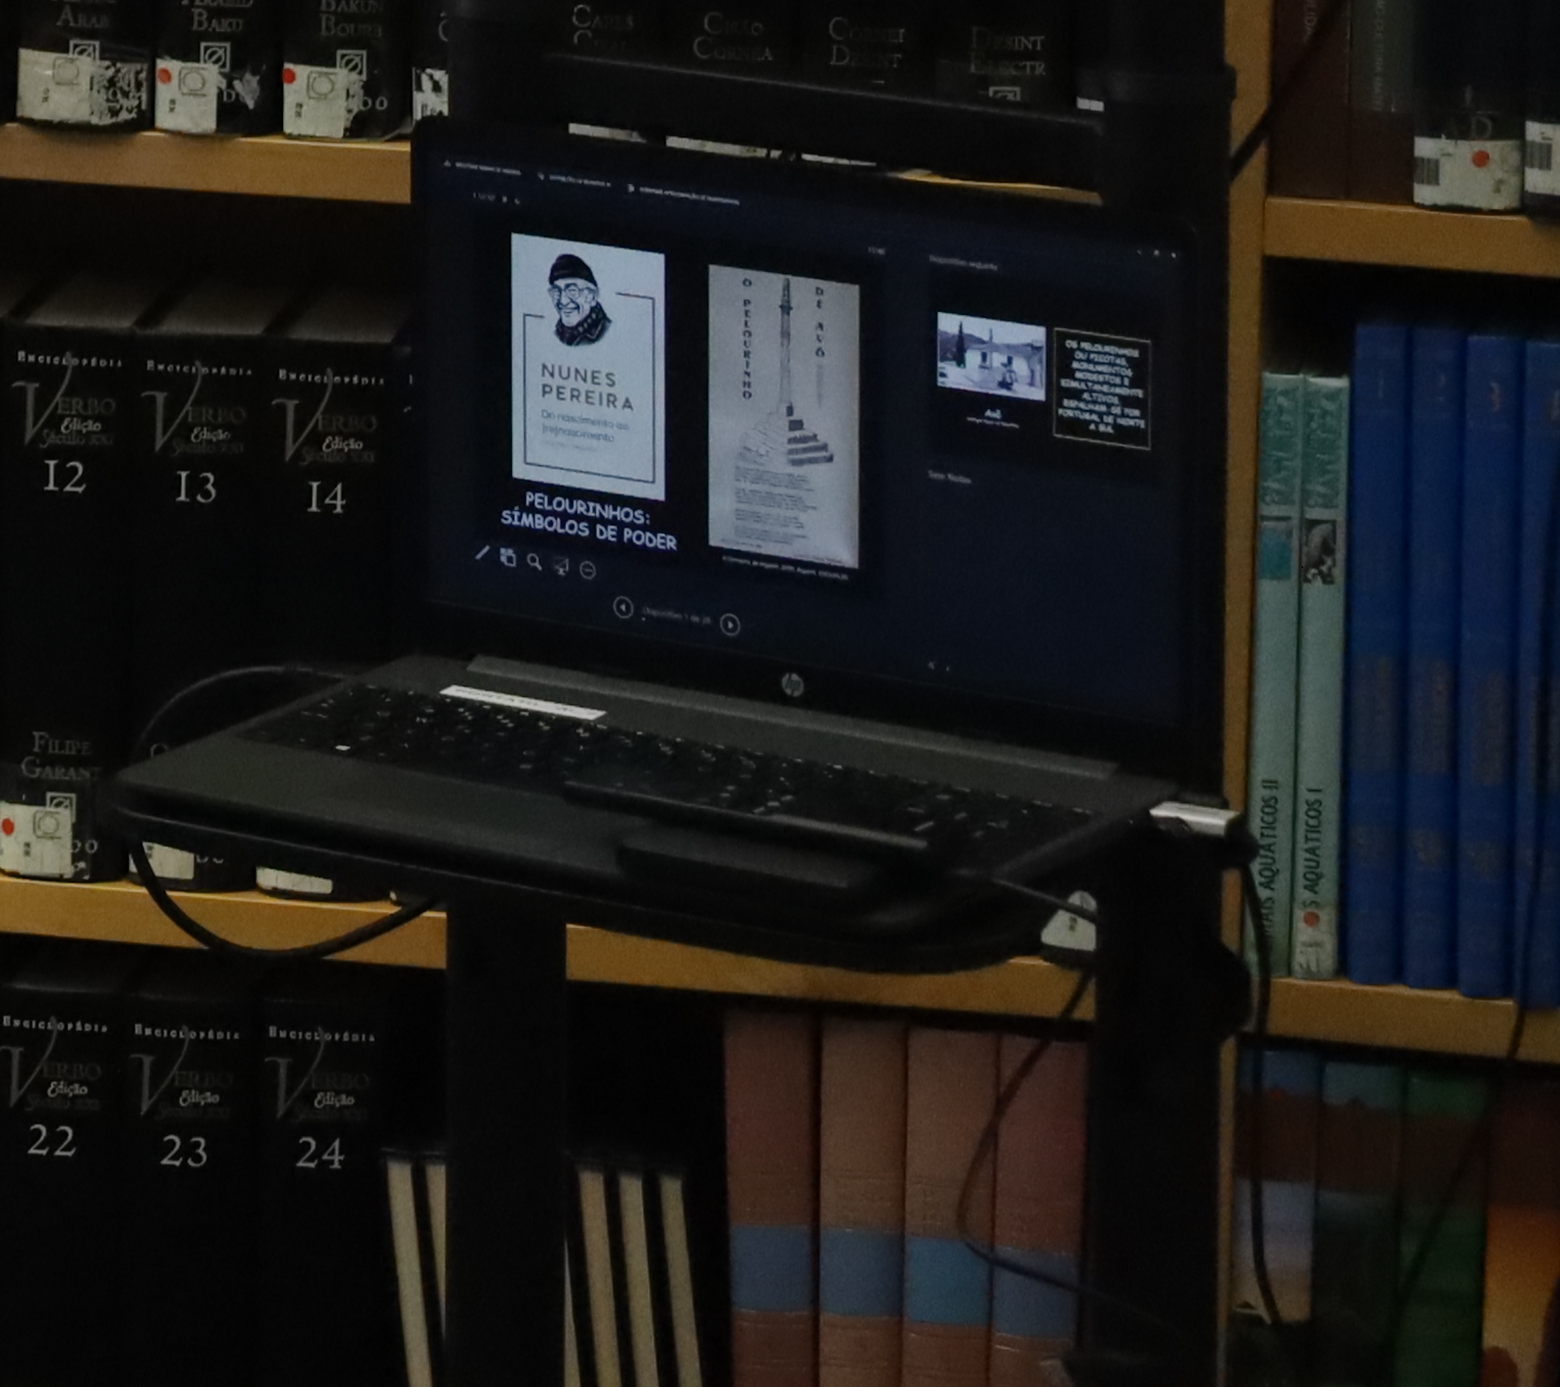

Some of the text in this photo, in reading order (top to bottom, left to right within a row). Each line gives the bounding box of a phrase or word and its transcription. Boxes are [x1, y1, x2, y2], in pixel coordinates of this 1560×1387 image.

[542, 363, 617, 388] NUNES
[542, 384, 633, 411] PEREIRA
[43, 460, 87, 494] 12
[175, 471, 218, 503] 13
[307, 481, 347, 514] 14
[526, 492, 651, 525] PELOURINHOS:
[501, 506, 677, 551] SÍMBOLOS DE PODER
[26, 1124, 77, 1157] 22
[160, 1134, 209, 1168] 23
[296, 1137, 345, 1169] 24
